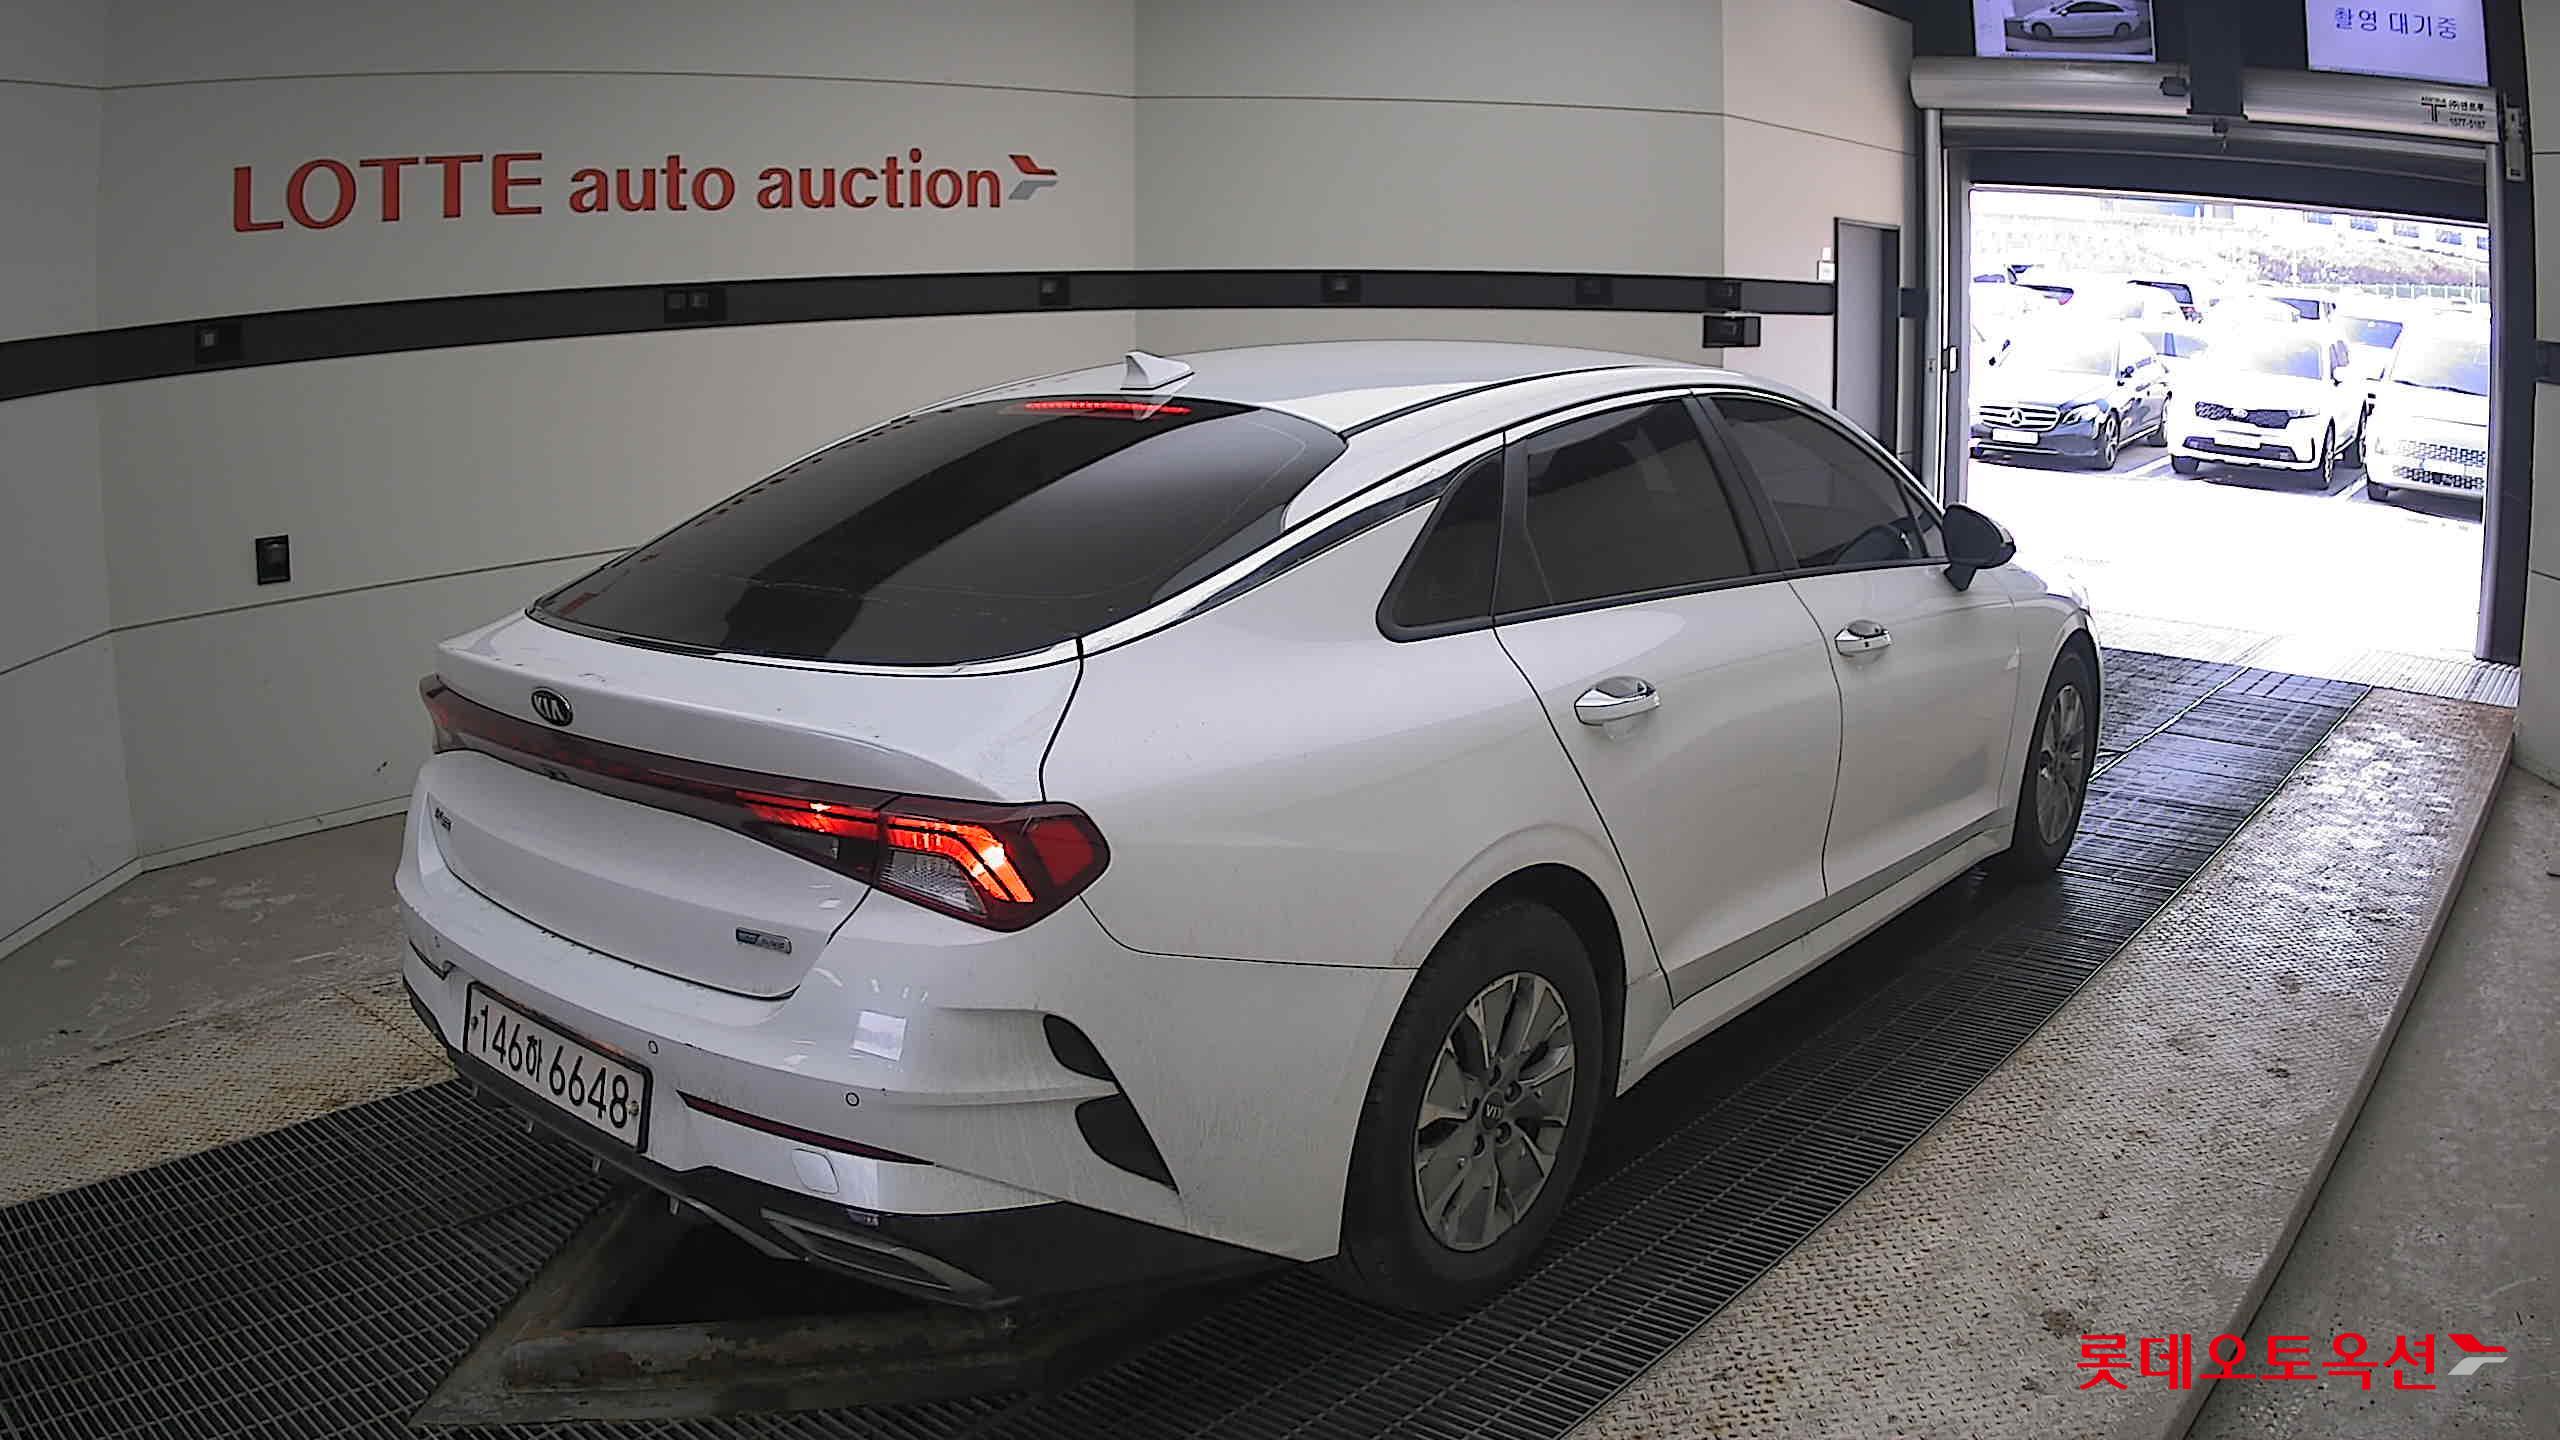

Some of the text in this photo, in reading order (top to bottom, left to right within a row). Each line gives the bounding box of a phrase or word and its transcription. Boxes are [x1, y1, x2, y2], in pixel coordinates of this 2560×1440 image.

[2335, 7, 2457, 40] 촬영 대기중
[233, 147, 1003, 233] LOTTE auto auction
[532, 693, 568, 723] KIA
[480, 1004, 630, 1129] 146하 6648
